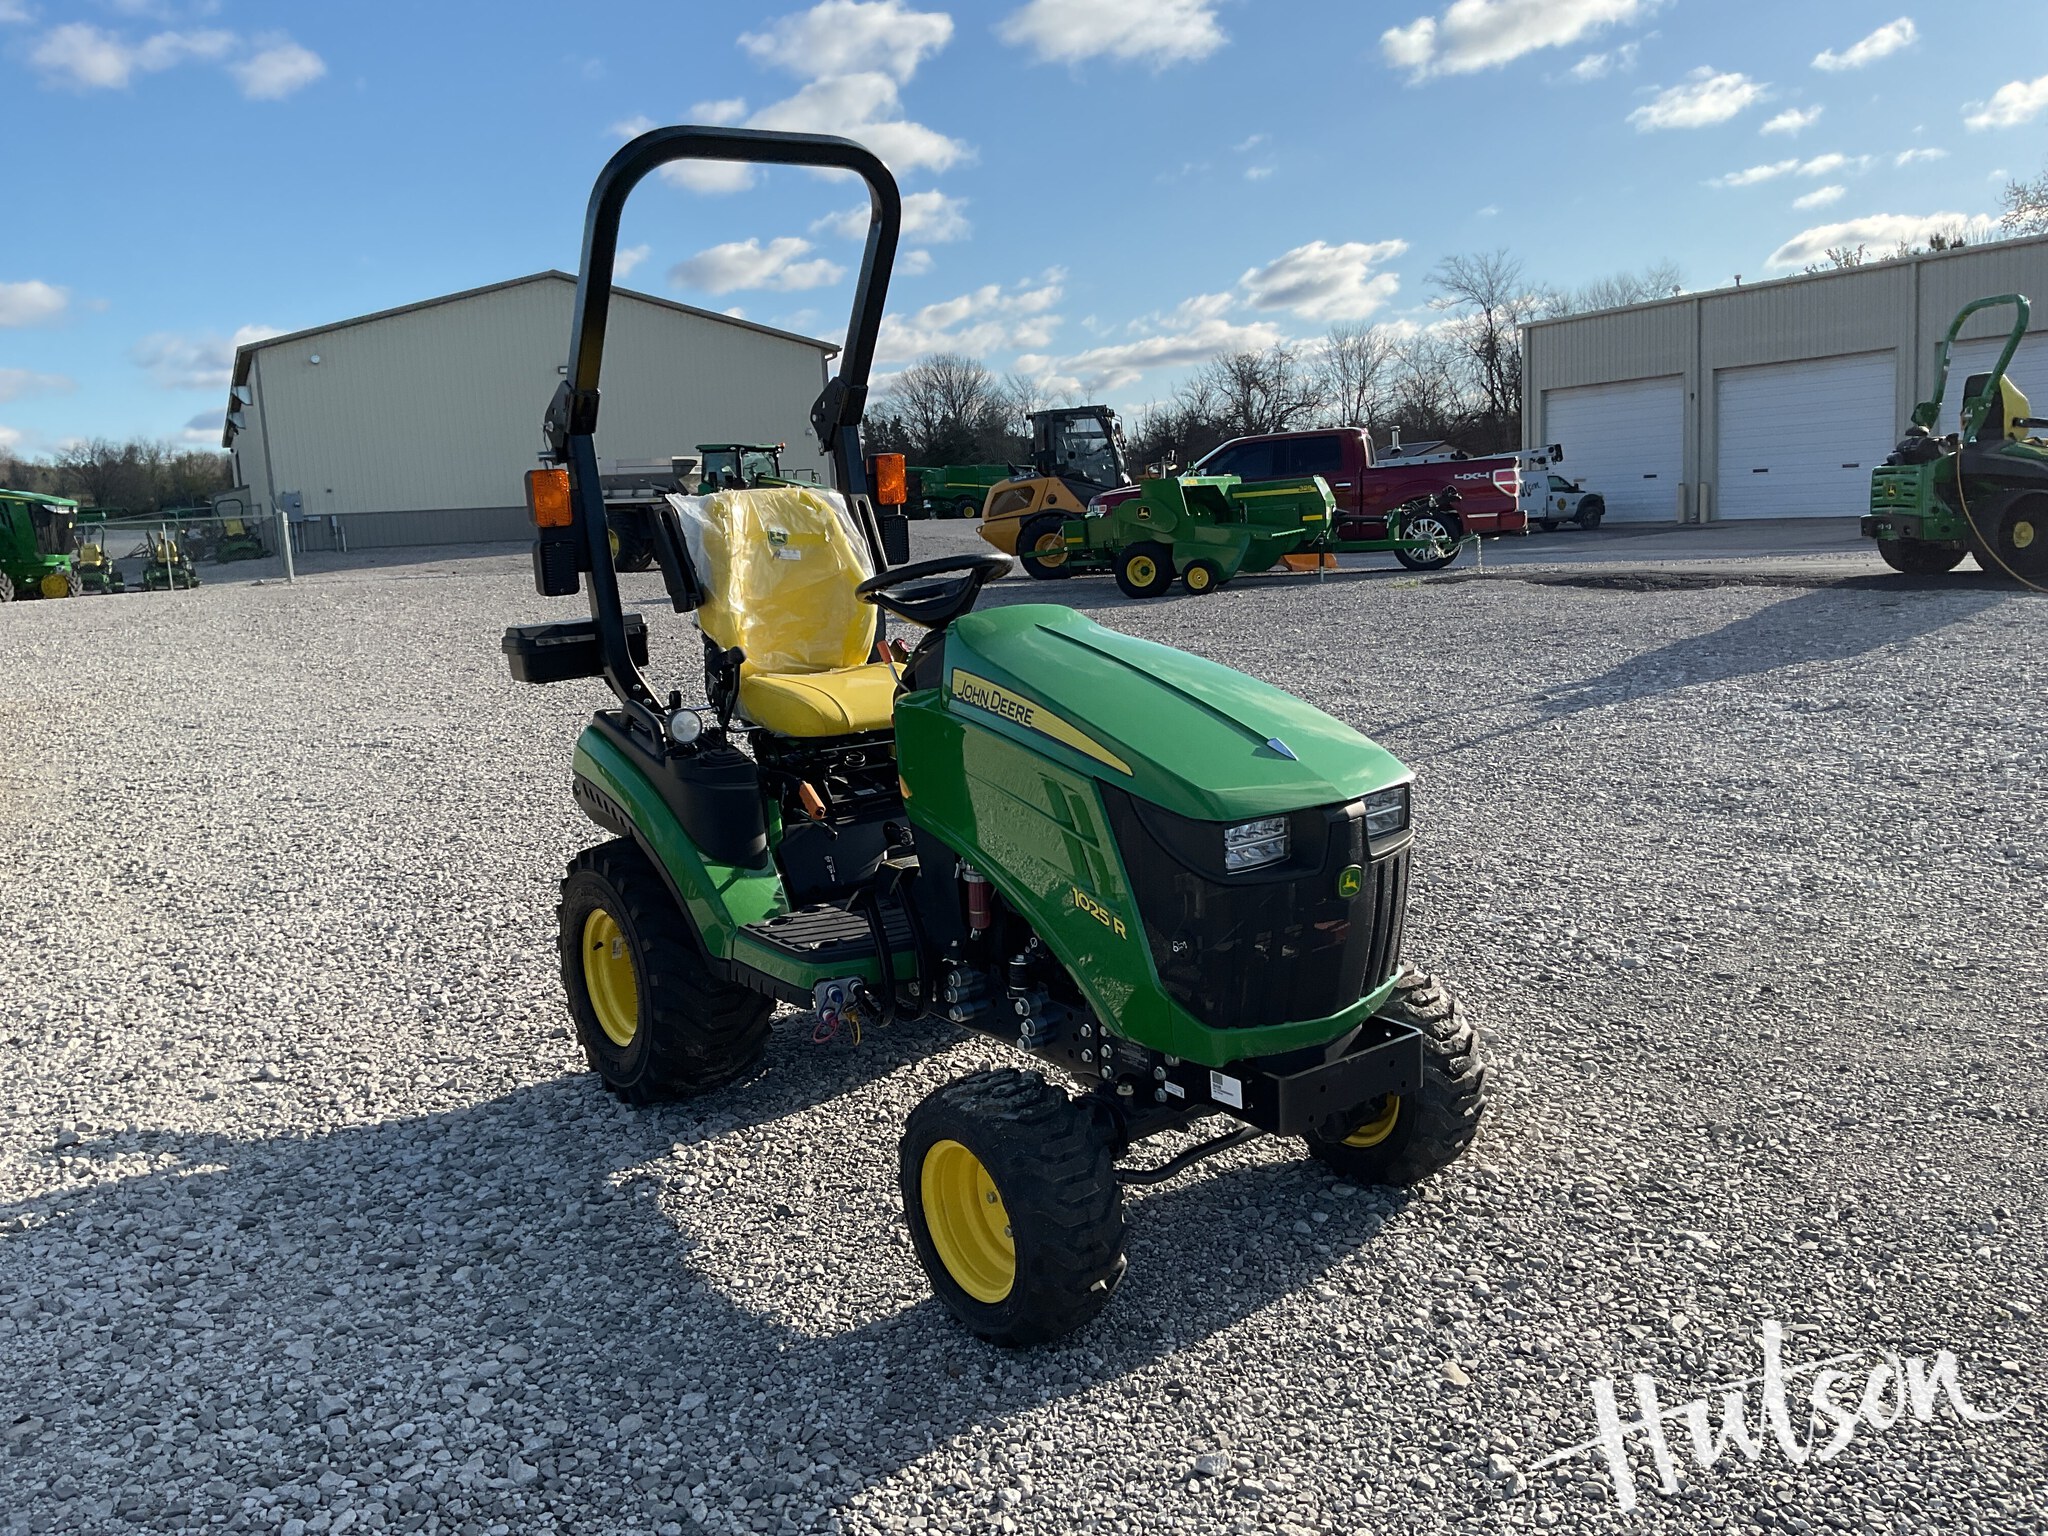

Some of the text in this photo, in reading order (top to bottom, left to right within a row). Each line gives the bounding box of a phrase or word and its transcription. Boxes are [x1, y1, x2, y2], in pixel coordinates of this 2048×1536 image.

[957, 680, 1034, 725] JOHN DEERE
[1072, 886, 1127, 941] 1025 R
